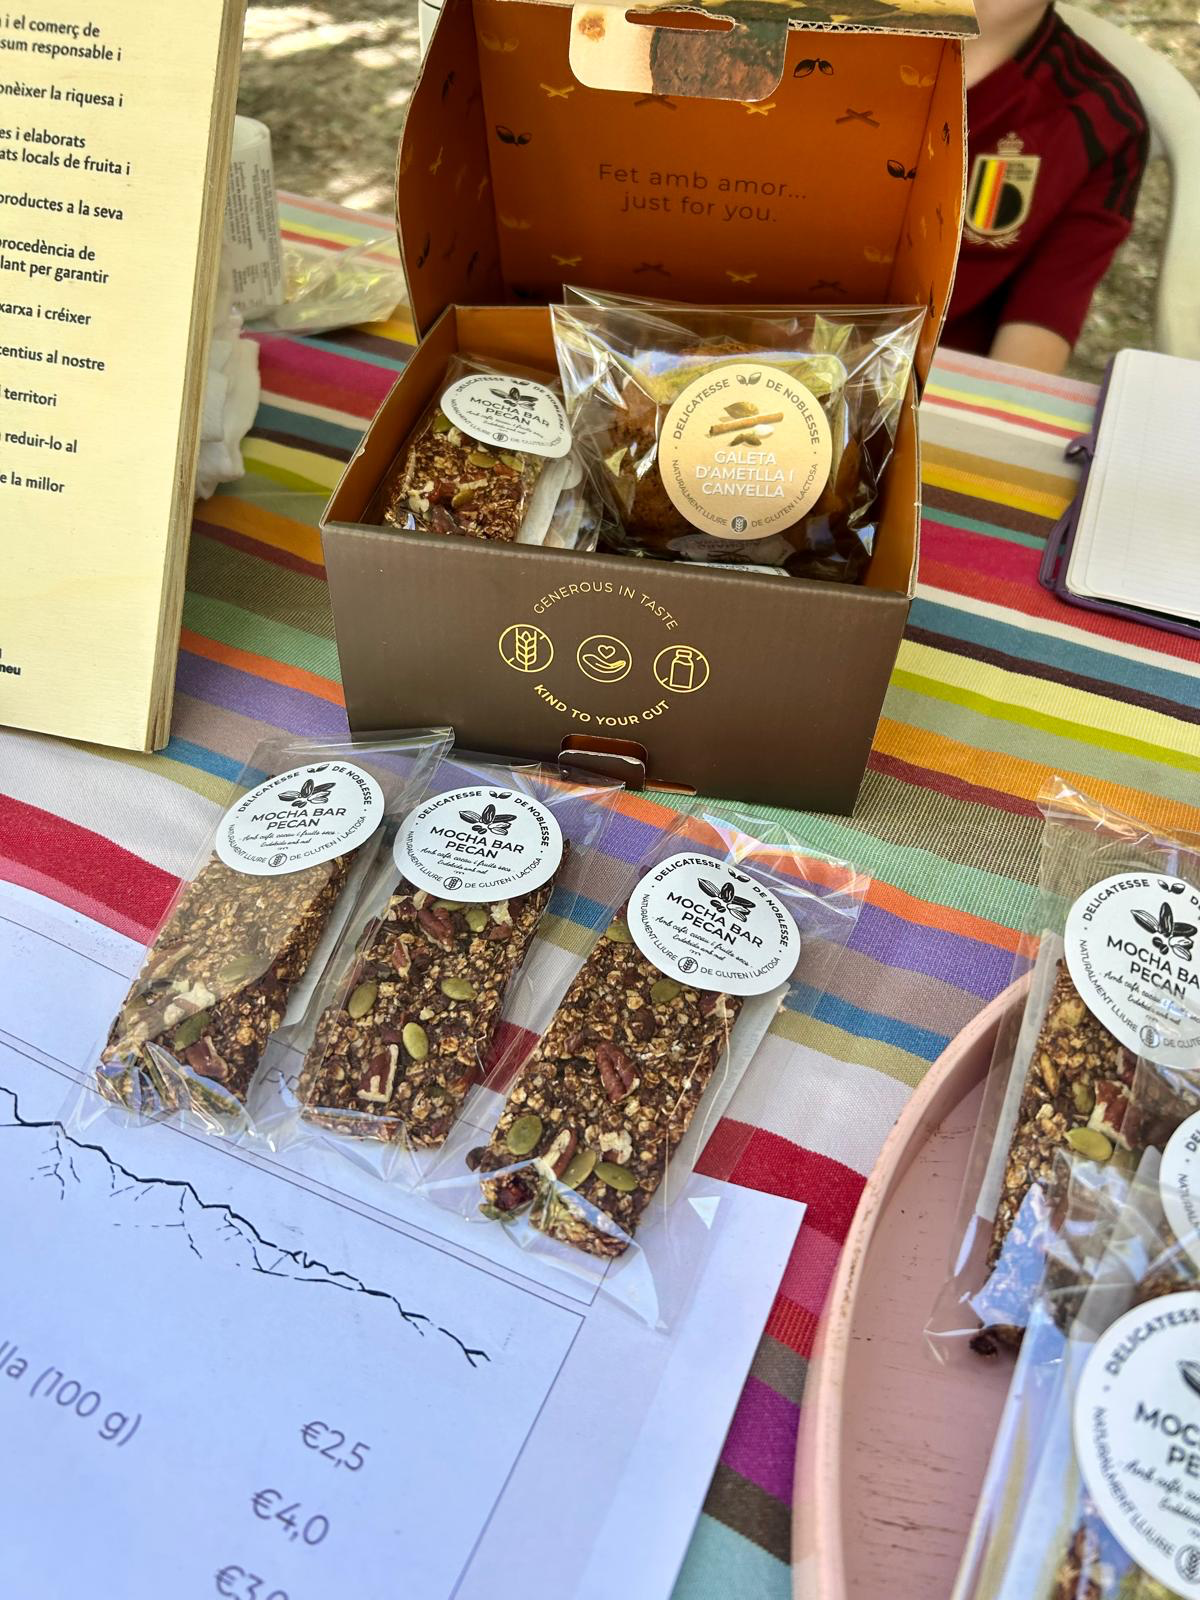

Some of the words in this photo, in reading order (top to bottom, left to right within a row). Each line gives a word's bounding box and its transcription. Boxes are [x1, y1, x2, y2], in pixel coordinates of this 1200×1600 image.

[5, 13, 10, 29] i
[13, 14, 26, 30] el
[29, 20, 80, 39] comerç
[82, 21, 101, 38] de
[32, 42, 114, 61] responsable
[116, 46, 122, 62] i
[50, 85, 63, 102] la
[65, 88, 115, 108] riquesa
[119, 93, 124, 107] i
[15, 127, 21, 141] i
[23, 128, 86, 149] elaborats
[22, 149, 60, 168] locals
[63, 153, 81, 171] de
[84, 156, 122, 176] fruita
[125, 161, 131, 176] i
[599, 163, 640, 184] Fet
[649, 170, 709, 191] amb
[718, 177, 807, 200] amor...
[67, 202, 74, 215] a
[78, 201, 91, 217] la
[94, 205, 124, 221] seva
[621, 191, 672, 213] just
[681, 195, 716, 217] for
[722, 203, 778, 223] you.
[79, 244, 96, 262] de
[29, 262, 51, 279] per
[54, 264, 110, 285] garantir
[37, 303, 42, 319] i
[45, 306, 92, 326] créixer
[46, 347, 59, 364] al
[62, 353, 106, 372] nostre
[4, 386, 58, 408] territori
[470, 396, 521, 416] MOCHA
[523, 411, 551, 428] BAR
[673, 378, 731, 441] DELICATESSE
[765, 378, 783, 394] DE
[783, 389, 821, 446] NOBLESSE
[485, 407, 531, 426] PECAN
[5, 431, 63, 451] reduir-lo
[65, 438, 78, 454] al
[714, 450, 778, 466] GALETA
[11, 471, 22, 487] la
[25, 475, 66, 494] millor
[695, 465, 786, 483] D'AMETLLA
[789, 468, 794, 482] I
[672, 459, 704, 515] NATURALMENT
[750, 518, 764, 528] DE
[764, 503, 796, 525] GLUTEN
[797, 462, 819, 501] LACTOSA
[702, 482, 786, 499] CANYELLA
[533, 581, 614, 615] GENEROUS
[618, 585, 637, 600] IN
[639, 593, 679, 631] TASTE
[534, 683, 568, 713] KIND
[571, 707, 592, 723] TO
[596, 714, 641, 727] YOUR
[642, 699, 671, 722] GUT
[238, 771, 301, 813] DELICATESSE
[331, 764, 346, 774] DE
[347, 770, 373, 806] NOBLESSE
[251, 809, 309, 823] MOCHA
[312, 807, 348, 818] BAR
[266, 817, 321, 831] PECAN
[418, 790, 483, 820] DELICATESSE
[514, 797, 529, 808] DE
[528, 806, 550, 847] NOBLESSE
[289, 853, 303, 861] DE
[303, 840, 337, 857] GLUTEN
[341, 815, 366, 838] LACTOSA
[430, 826, 488, 847] MOCHA
[491, 839, 525, 855] BAR
[445, 840, 499, 859] PECAN
[478, 877, 512, 889] GLUTEN
[516, 856, 543, 879] LACTOSA
[654, 857, 722, 883] DELICATESSE
[752, 886, 768, 898] DE
[766, 899, 790, 948] NOBLESSE
[1082, 878, 1151, 922] DELICATESSE
[666, 891, 727, 928] MOCHA
[730, 922, 764, 949] BAR
[681, 911, 738, 946] PECAN
[640, 893, 658, 940] NATURALMENT
[653, 940, 679, 961] LLIURE
[700, 965, 713, 976] DE
[715, 969, 749, 980] GLUTEN
[754, 956, 781, 978] LACTOSA
[1106, 935, 1173, 976] MOCHA
[1079, 938, 1113, 1004] NATURALMENT
[1110, 1003, 1139, 1033] LLIURE
[1129, 961, 1187, 1000] PECAN
[30, 1366, 101, 1418] (100
[98, 1411, 142, 1447] g)
[300, 1420, 371, 1472] €2,5
[250, 1488, 330, 1545] €4,0
